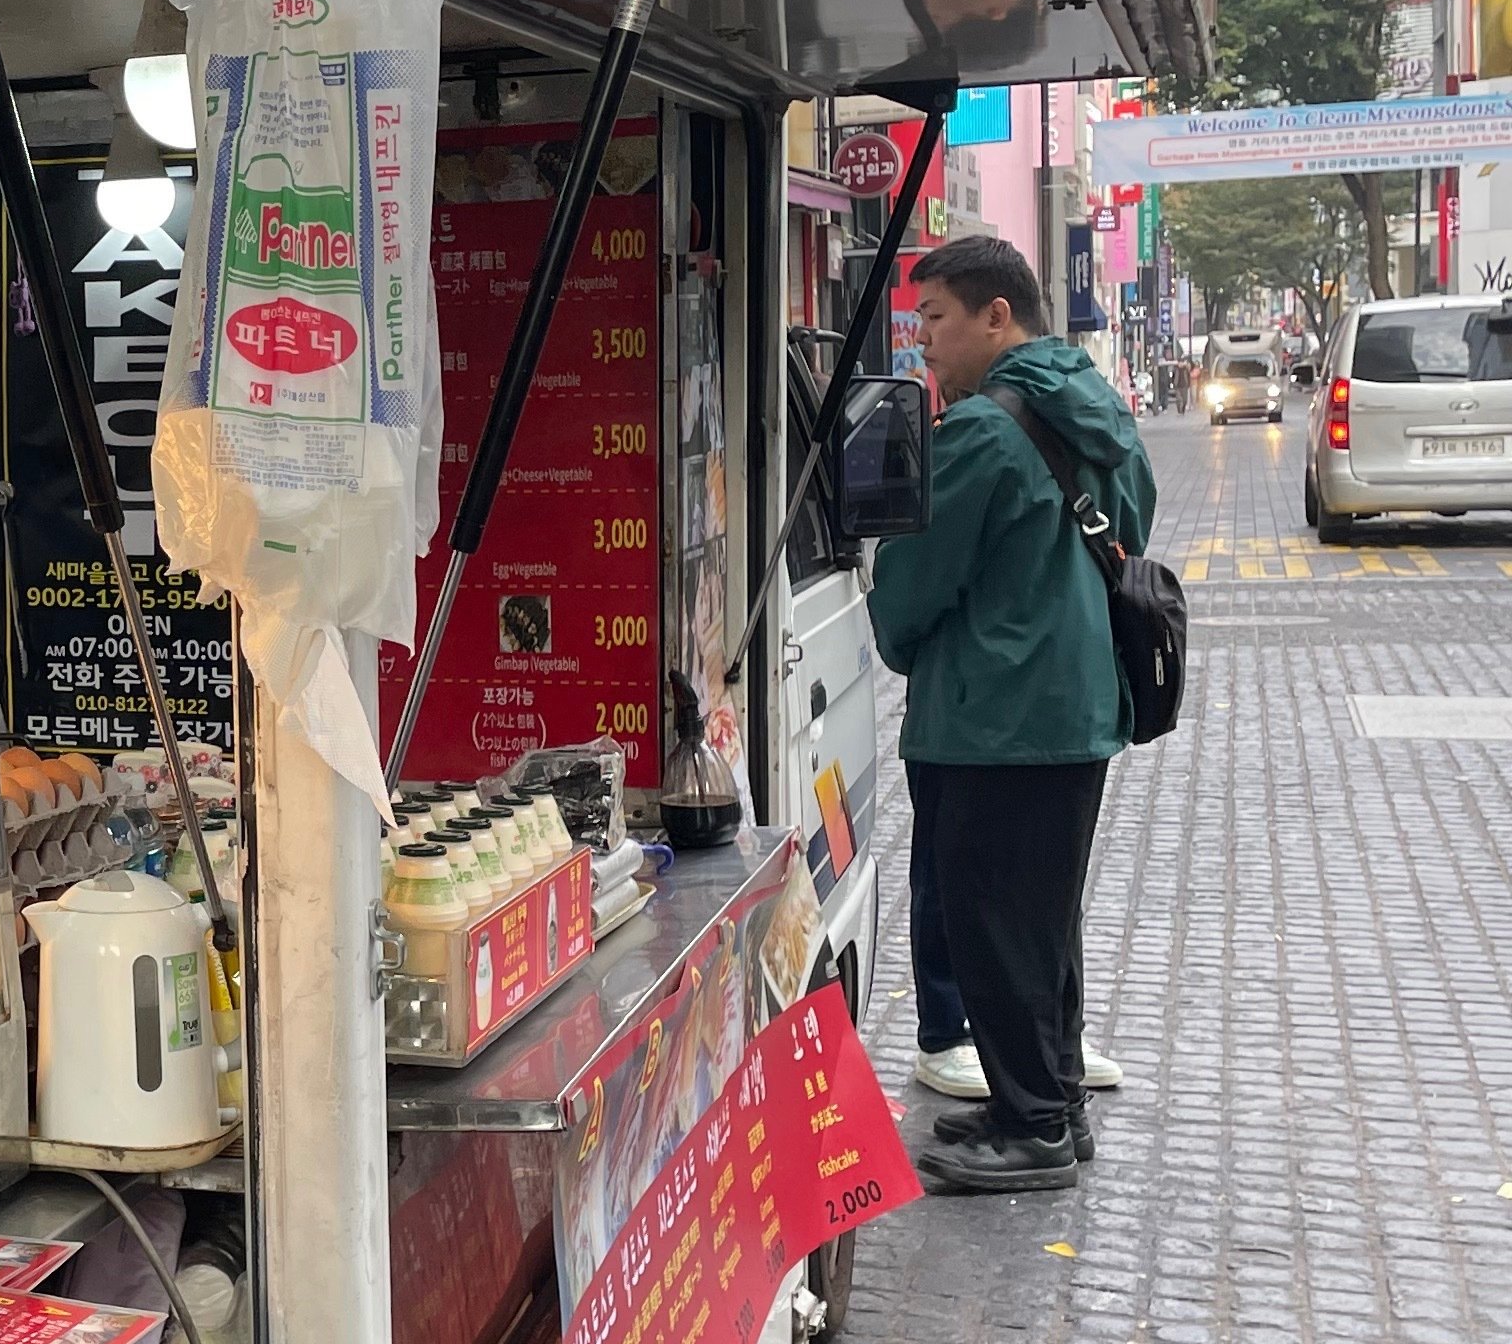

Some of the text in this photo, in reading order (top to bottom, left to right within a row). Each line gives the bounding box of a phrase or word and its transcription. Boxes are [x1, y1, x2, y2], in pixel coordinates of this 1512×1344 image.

[1187, 115, 1267, 135] Welcome
[591, 229, 646, 265] 4,000
[235, 322, 342, 360] 파트너
[592, 327, 646, 364] 3,500
[592, 424, 646, 459] 3,500
[593, 518, 647, 553] 3,000
[492, 561, 557, 580] Egg+Vegetable
[108, 615, 171, 636] OEN
[594, 616, 648, 651] 3,000
[46, 662, 232, 698] 전화 가능
[482, 687, 535, 706] 포장가능
[27, 716, 139, 747] 모든메뉴
[596, 703, 648, 737] 2,000
[817, 1147, 860, 1180] Fishcake
[825, 1179, 883, 1225] 2,000
